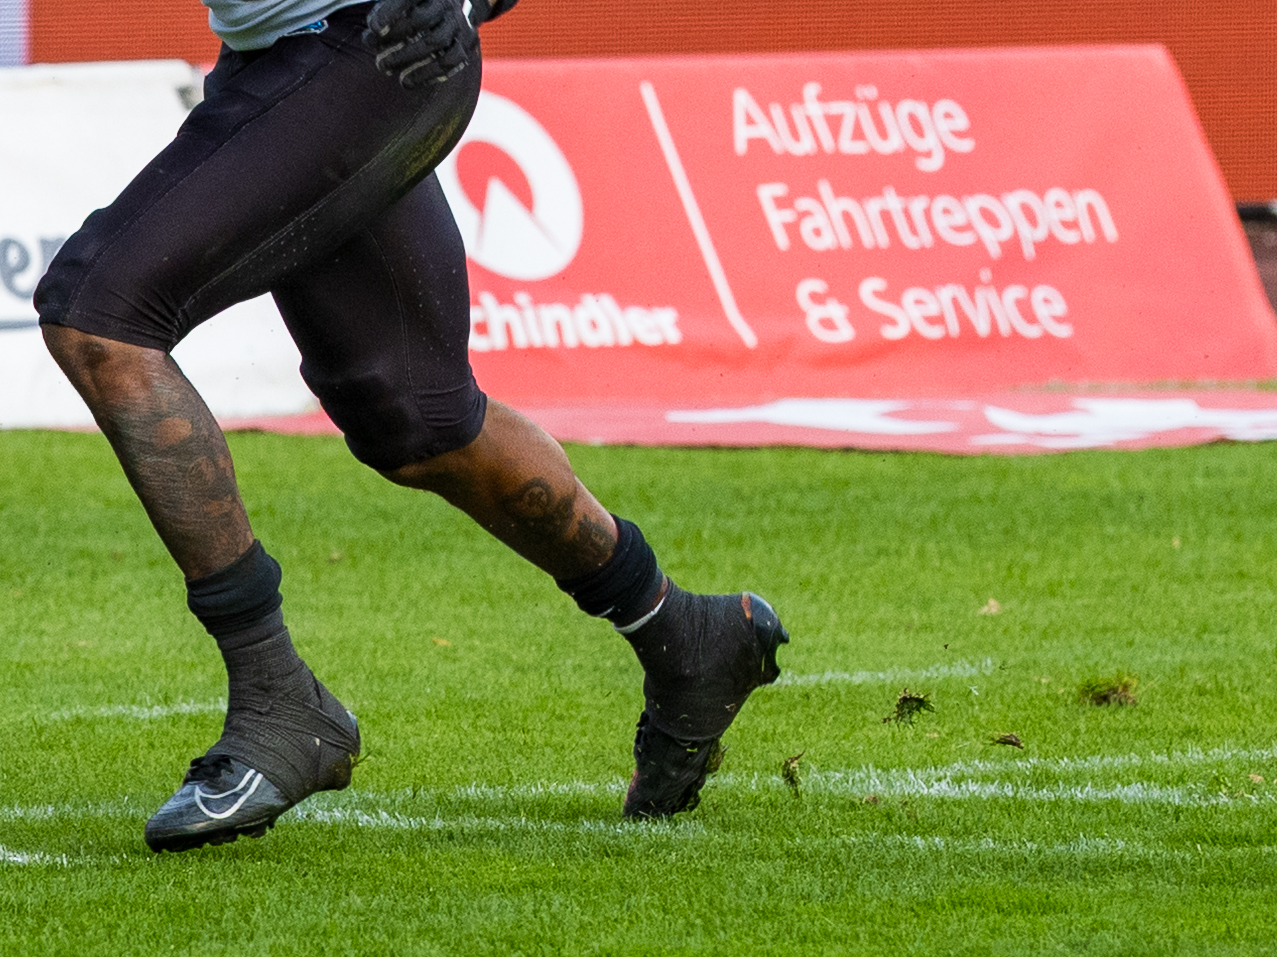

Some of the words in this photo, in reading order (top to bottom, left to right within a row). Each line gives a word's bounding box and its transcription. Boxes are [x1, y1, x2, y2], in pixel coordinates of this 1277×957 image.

[732, 82, 976, 173] Aufzüge
[756, 178, 1120, 261] Fahrtreppen
[795, 278, 856, 344] &
[858, 267, 1074, 340] Service
